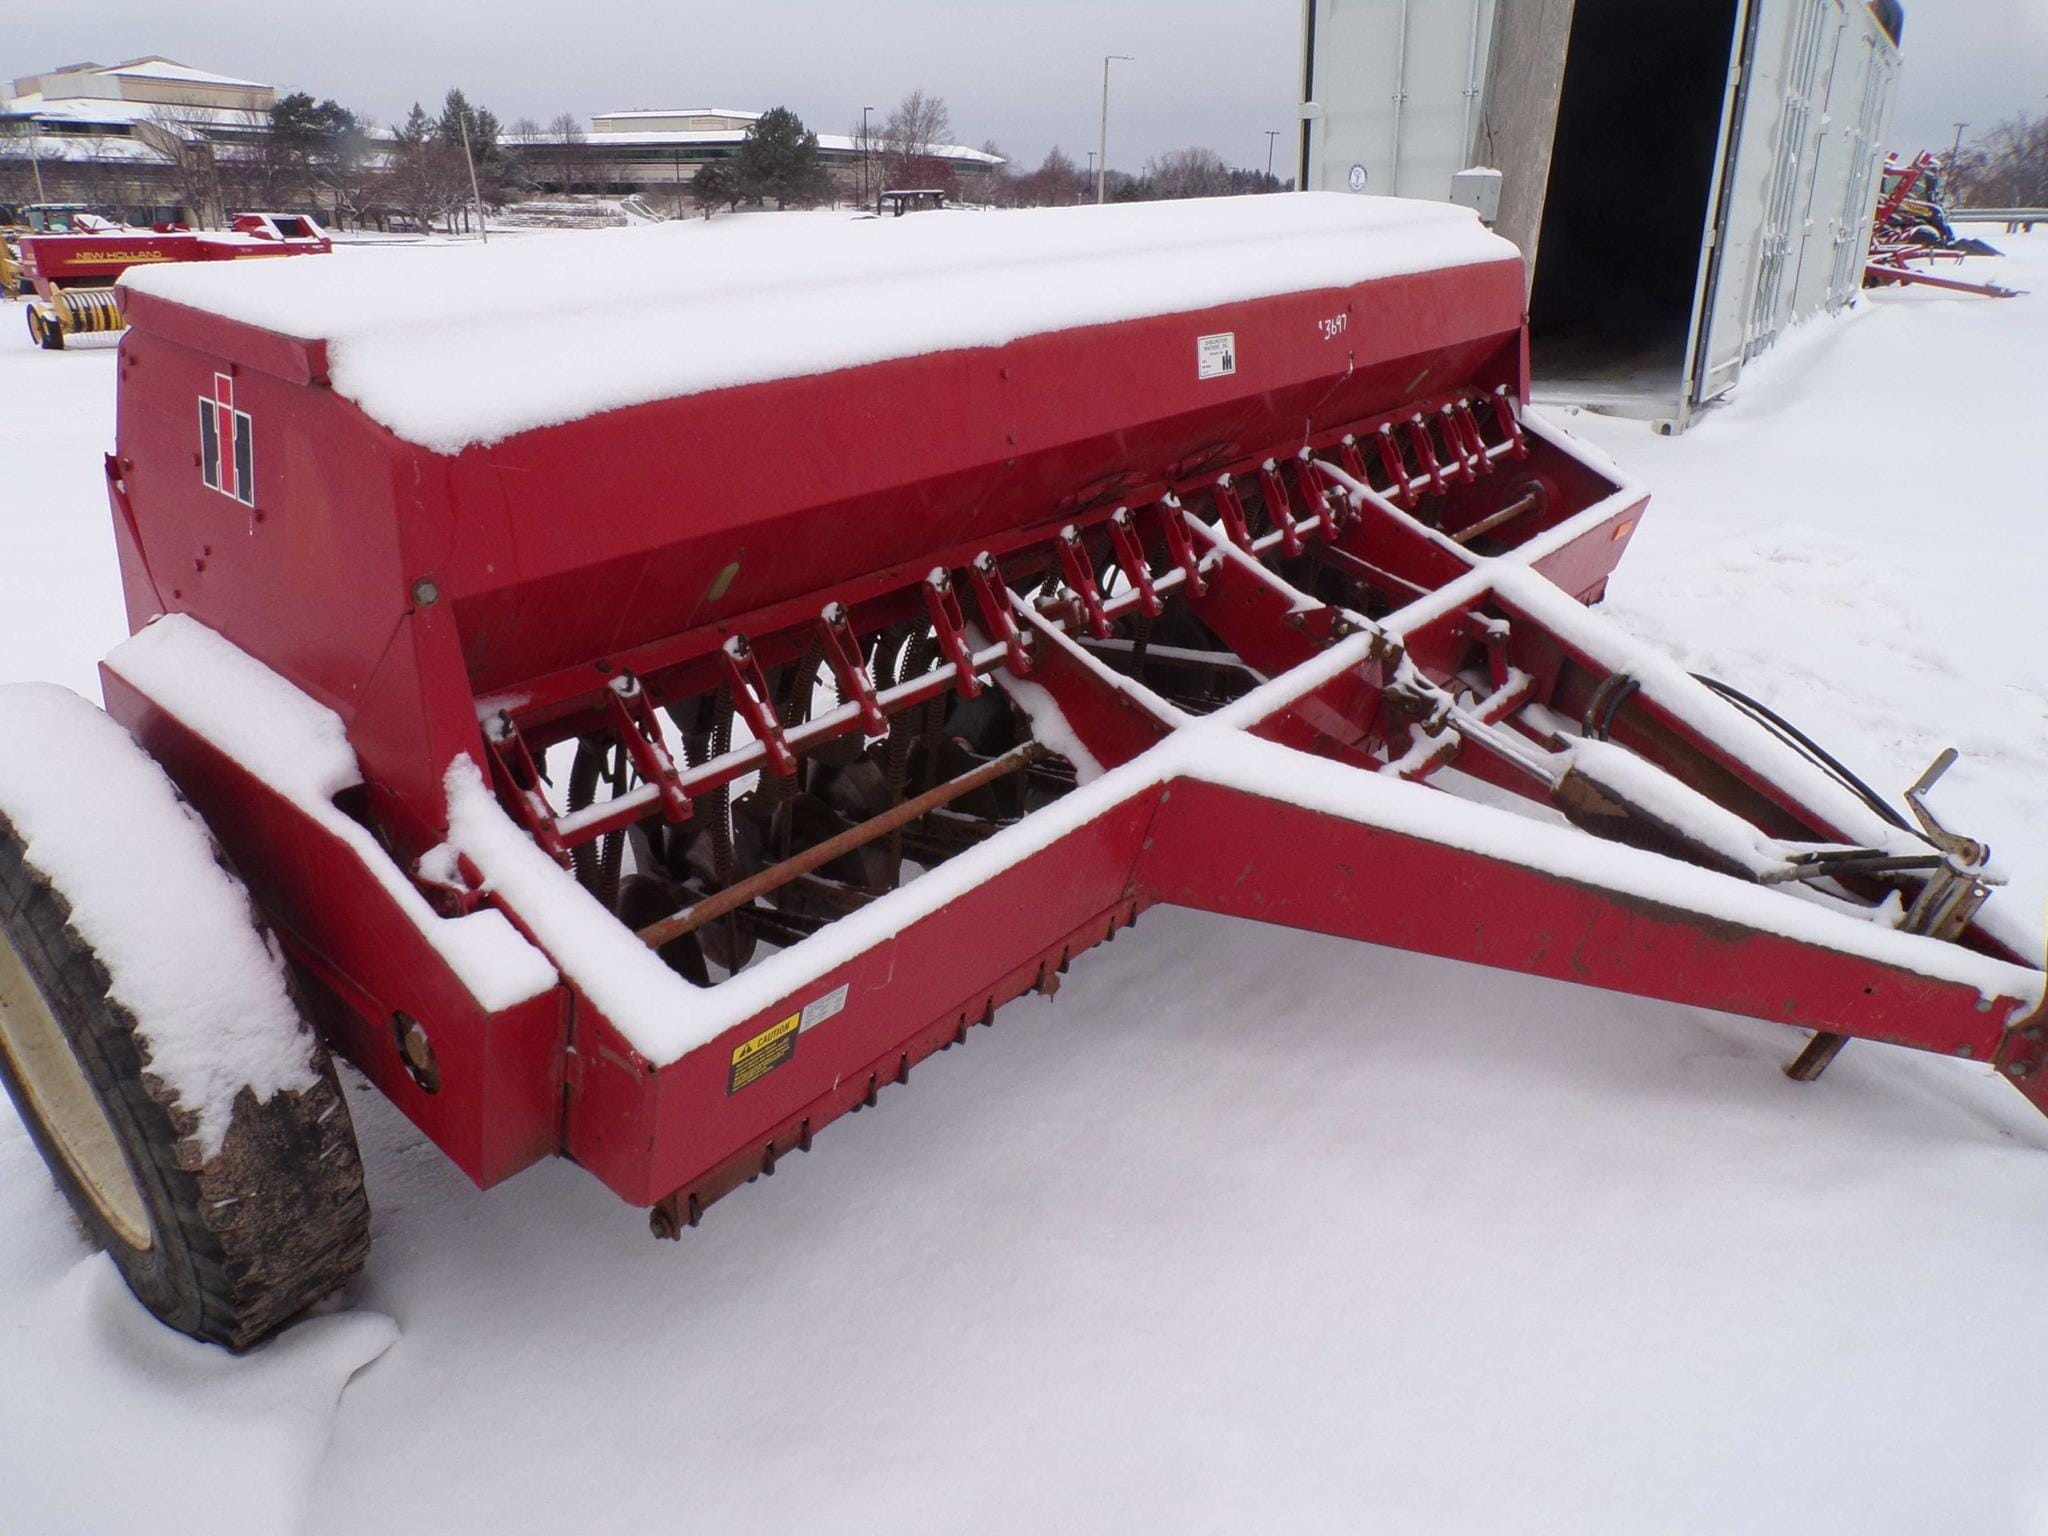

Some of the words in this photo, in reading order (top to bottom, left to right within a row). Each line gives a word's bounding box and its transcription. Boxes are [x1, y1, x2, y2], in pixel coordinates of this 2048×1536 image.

[75, 251, 104, 259] NEW
[106, 250, 162, 259] HOLLAND
[757, 1020, 791, 1048] CAUTION
